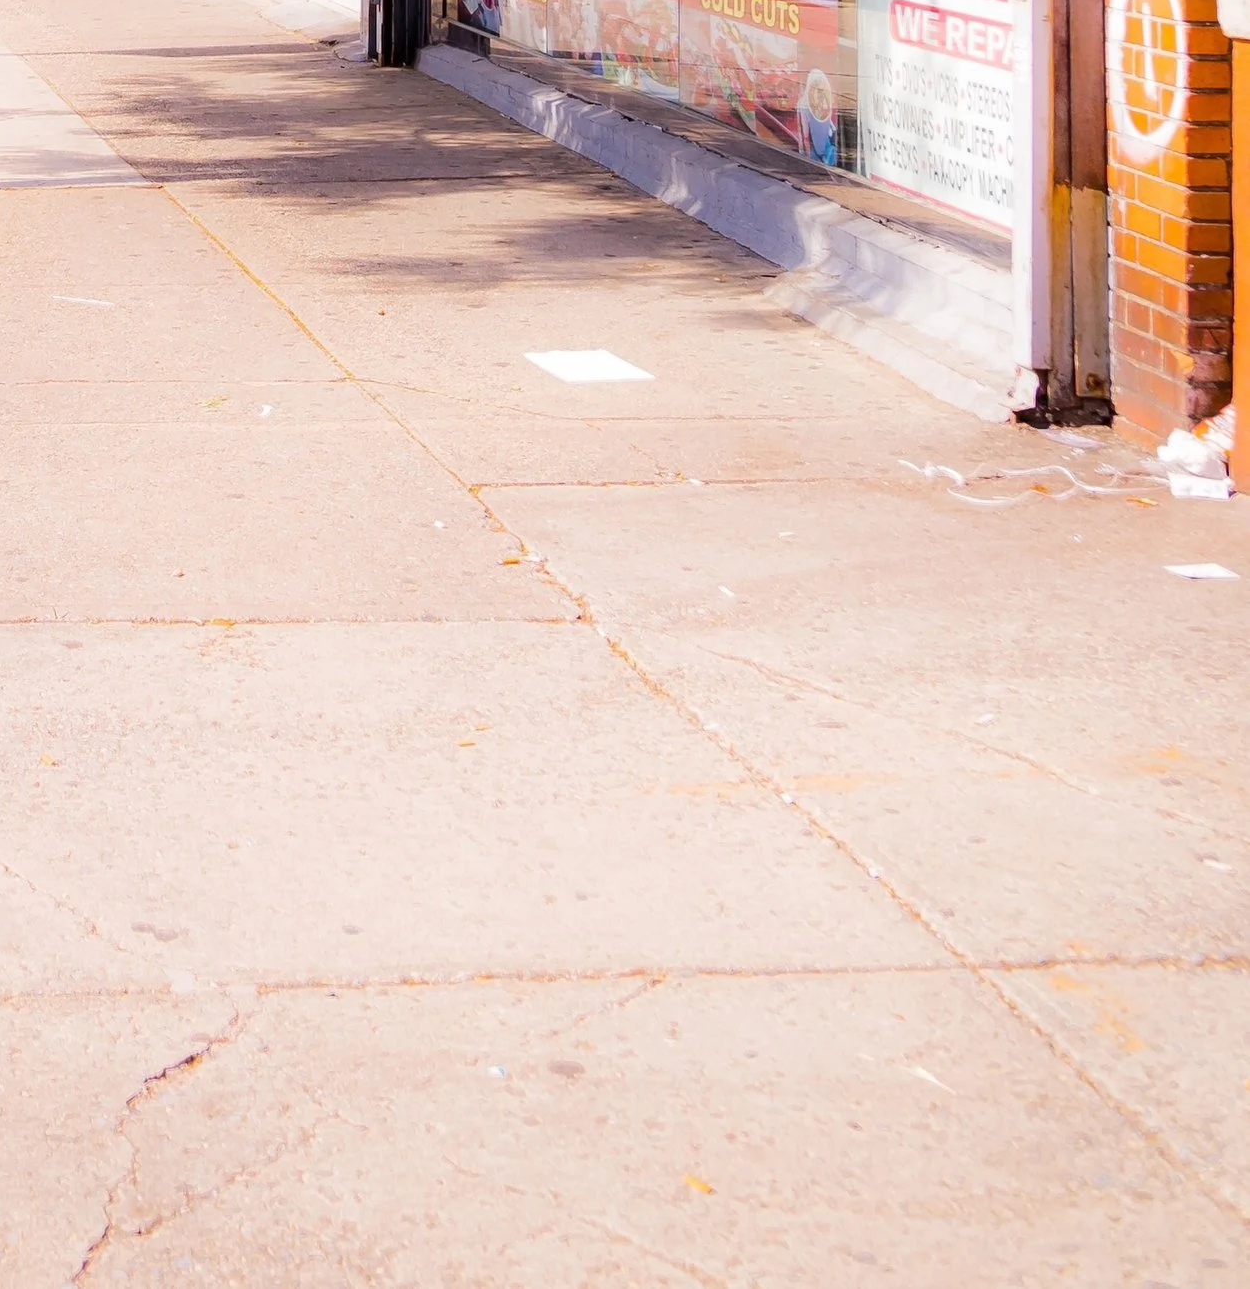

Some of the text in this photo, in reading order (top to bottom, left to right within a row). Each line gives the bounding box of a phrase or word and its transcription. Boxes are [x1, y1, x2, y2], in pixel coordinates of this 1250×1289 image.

[894, 2, 940, 48] WE
[867, 128, 888, 163] TAPE
[890, 137, 919, 175] DECKS
